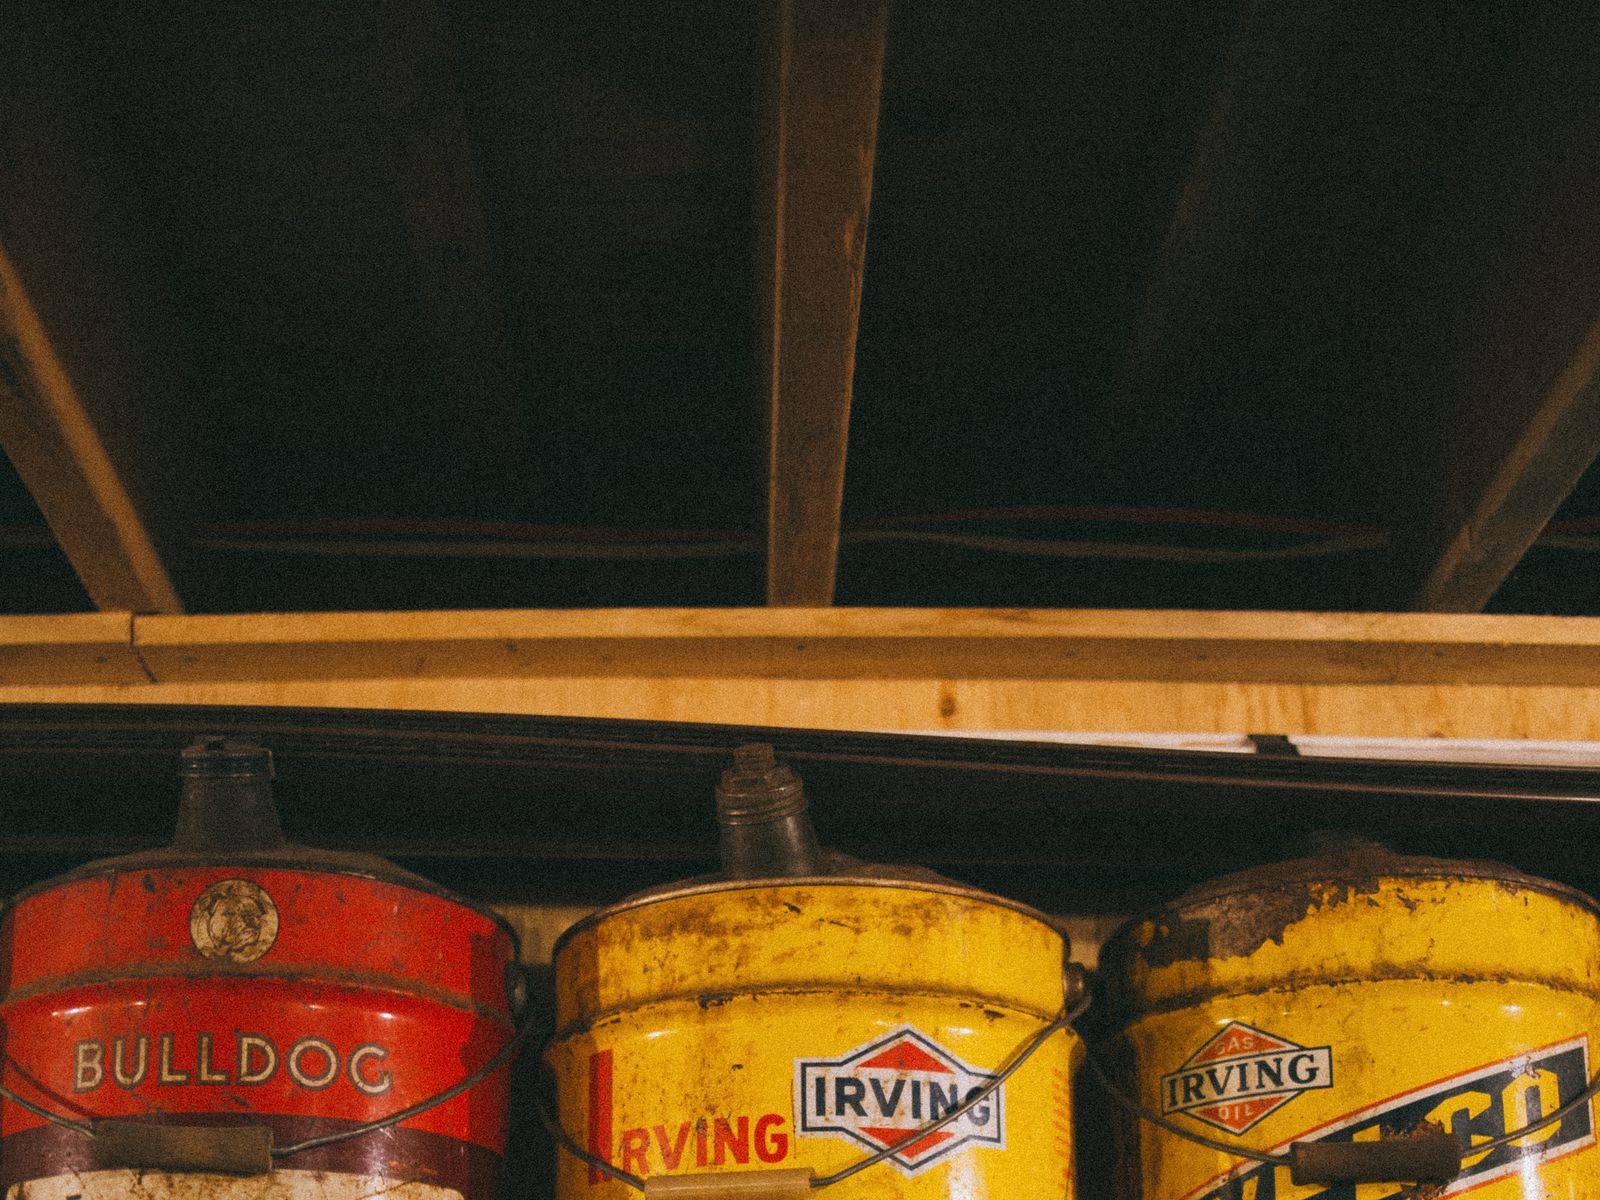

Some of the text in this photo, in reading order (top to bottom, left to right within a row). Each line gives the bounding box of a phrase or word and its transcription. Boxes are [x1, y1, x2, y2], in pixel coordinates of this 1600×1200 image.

[74, 1031, 394, 1096] BULLDOG
[1215, 1036, 1254, 1055] GAS
[815, 1076, 991, 1127] IRVING
[1167, 1053, 1320, 1108] IRVING
[588, 1049, 788, 1186] IRVING
[1218, 1105, 1254, 1122] OIL
